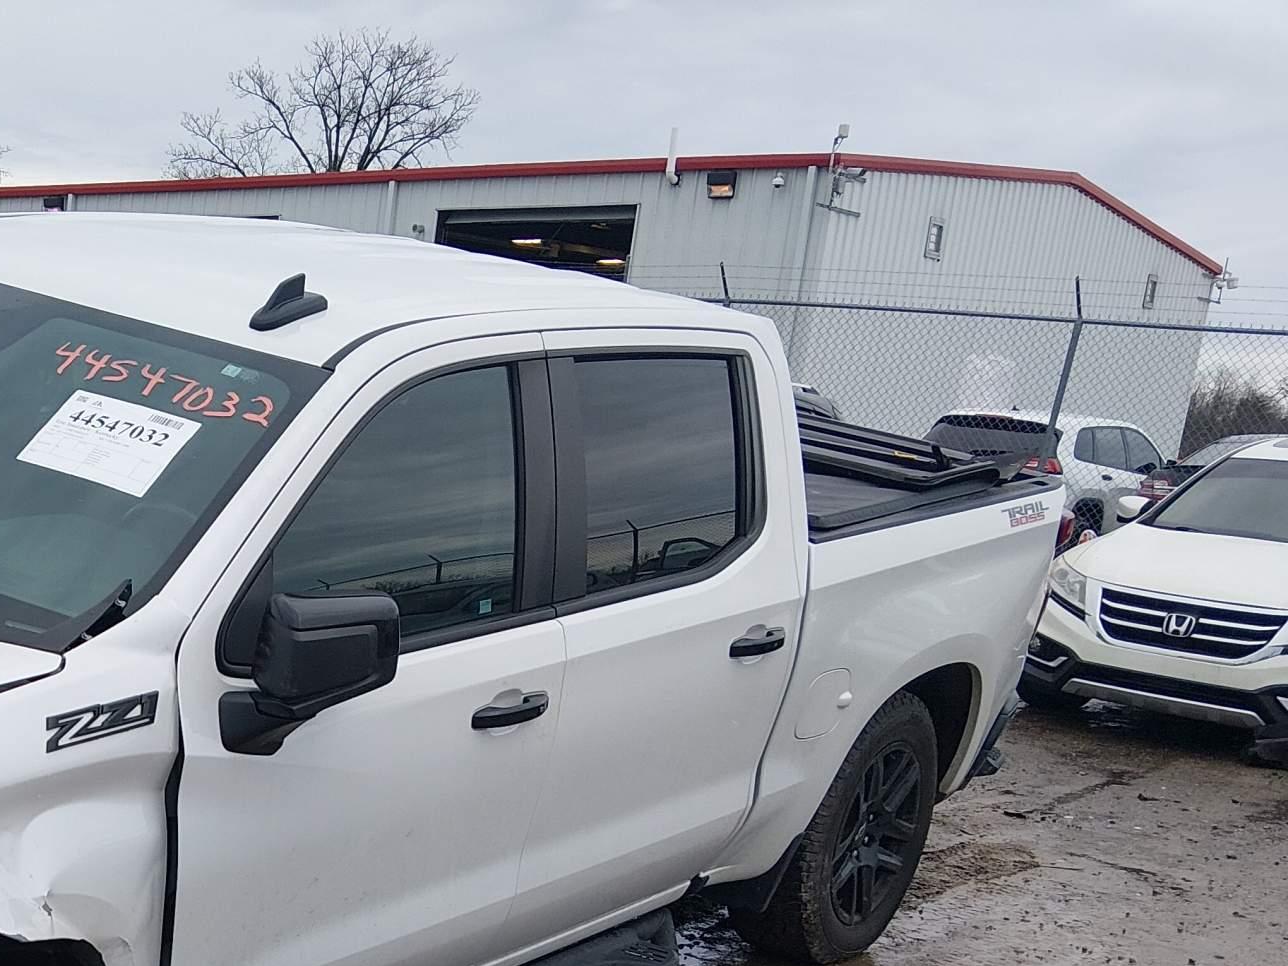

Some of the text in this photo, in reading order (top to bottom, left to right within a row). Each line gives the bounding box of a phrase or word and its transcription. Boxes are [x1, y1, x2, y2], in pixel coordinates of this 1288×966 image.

[55, 341, 274, 427] 44547032
[69, 409, 170, 447] 44547032
[1001, 501, 1050, 519] TRAIL
[1010, 511, 1046, 528] BOSS
[45, 689, 159, 754] Z71
